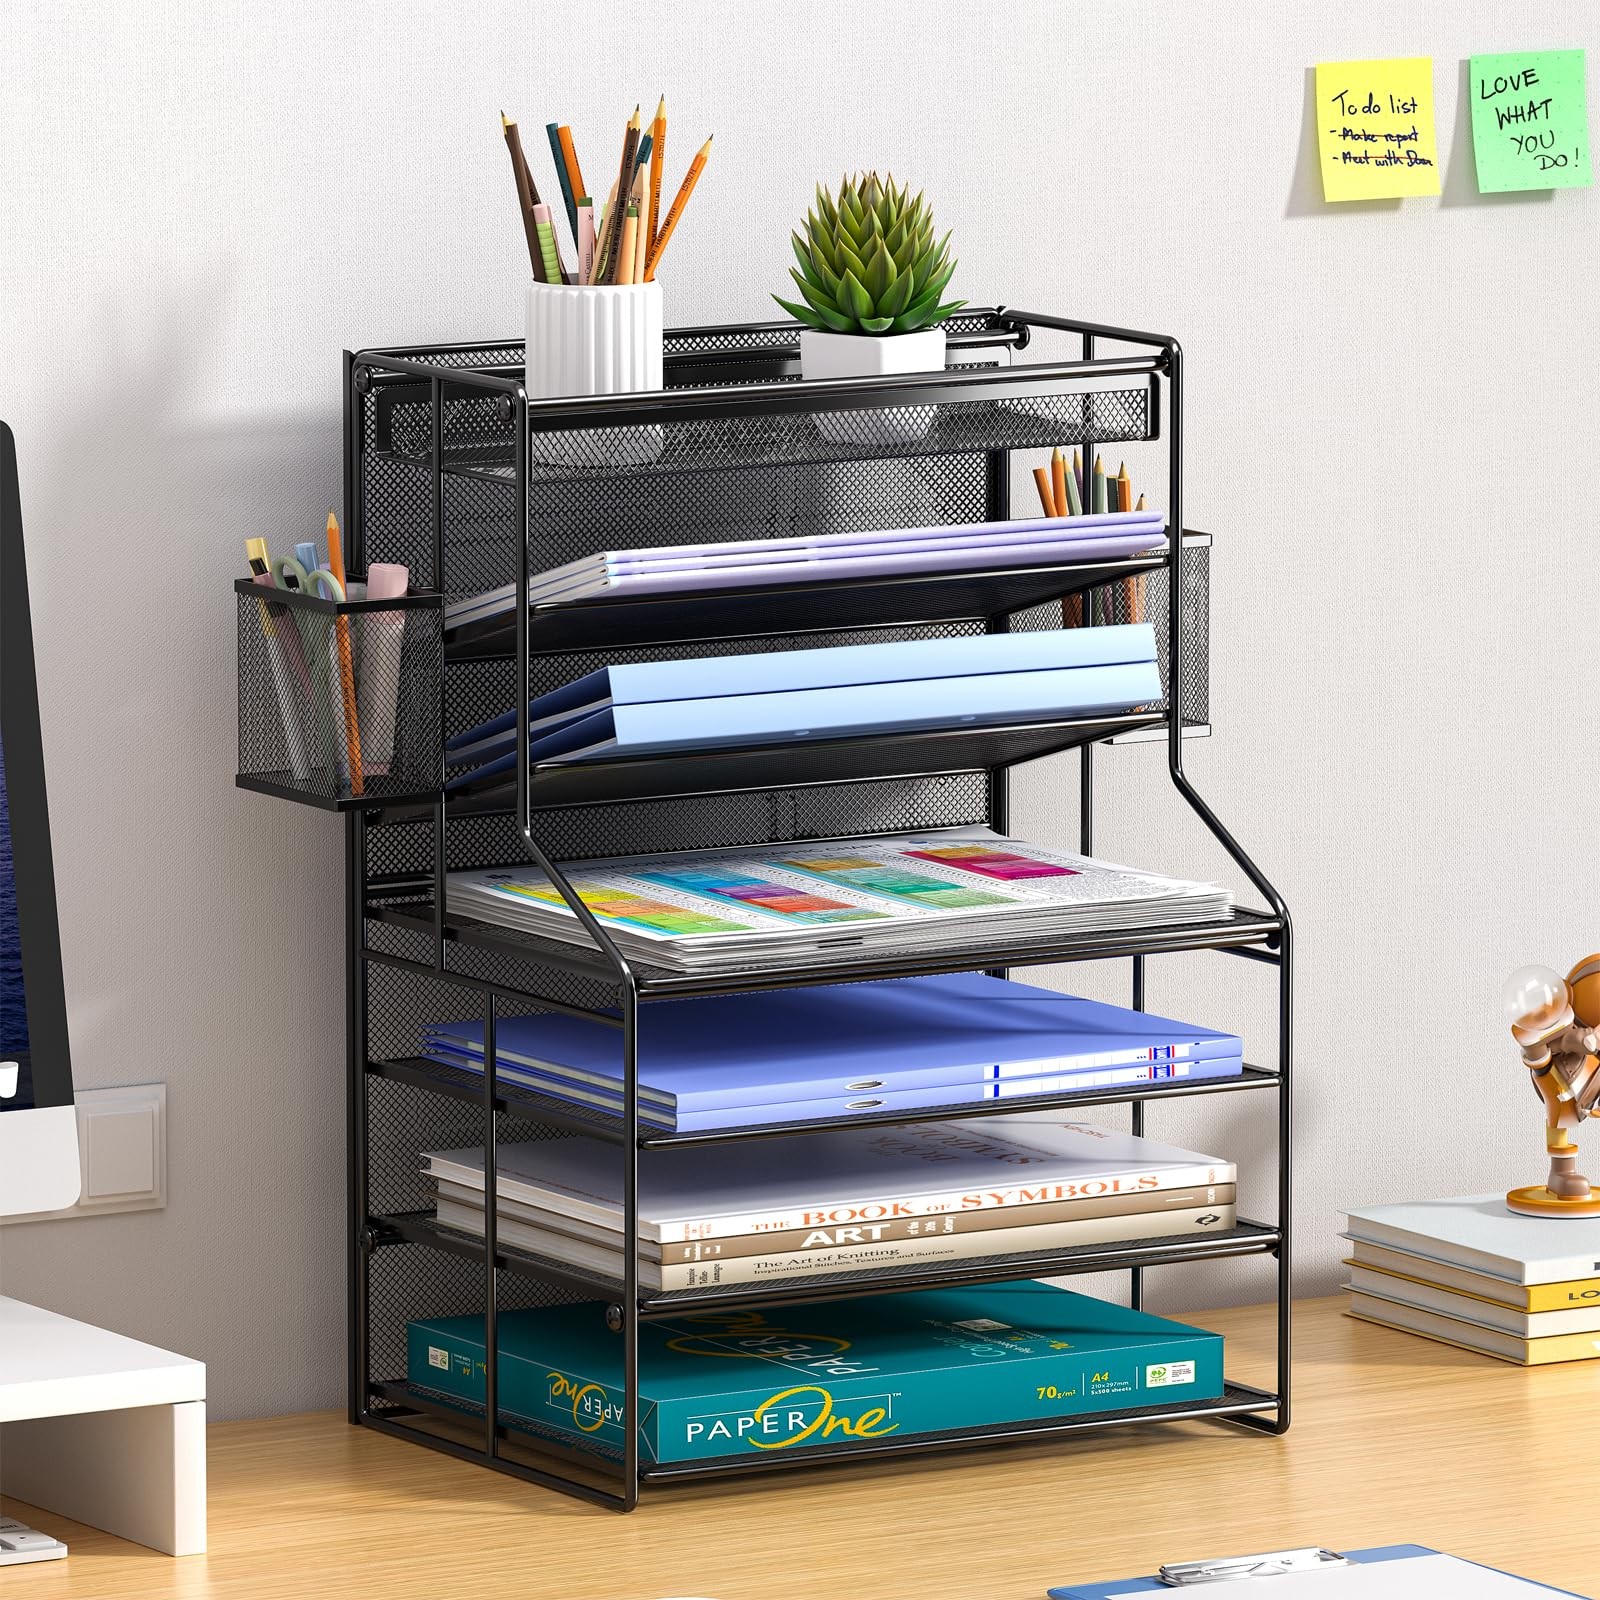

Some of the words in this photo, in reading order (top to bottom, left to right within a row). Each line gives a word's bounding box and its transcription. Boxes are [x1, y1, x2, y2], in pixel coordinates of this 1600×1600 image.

[1480, 68, 1540, 100] LOVE
[1332, 90, 1357, 116] To
[1363, 92, 1381, 114] do
[1390, 95, 1418, 114] list
[1495, 98, 1553, 130] WHAT
[1510, 130, 1555, 156] YOU
[1375, 149, 1403, 167] with
[752, 1221, 790, 1231] THE
[802, 1201, 913, 1226] BOOK
[927, 1203, 950, 1212] OF
[961, 1174, 1161, 1210] SYMBOLS
[800, 1223, 891, 1248] ART
[753, 1261, 783, 1269] The
[788, 1257, 813, 1265] Art
[817, 1254, 833, 1262] of
[837, 1248, 900, 1260] Knitting
[754, 1264, 813, 1274] Inspirational
[1568, 1290, 1600, 1300] LO
[738, 1335, 881, 1376] PAPER
[1091, 1371, 1109, 1383] A4
[1111, 1386, 1132, 1394] sheets
[581, 1394, 624, 1422] APER
[686, 1411, 808, 1443] PAPER
[748, 1385, 900, 1449] One
